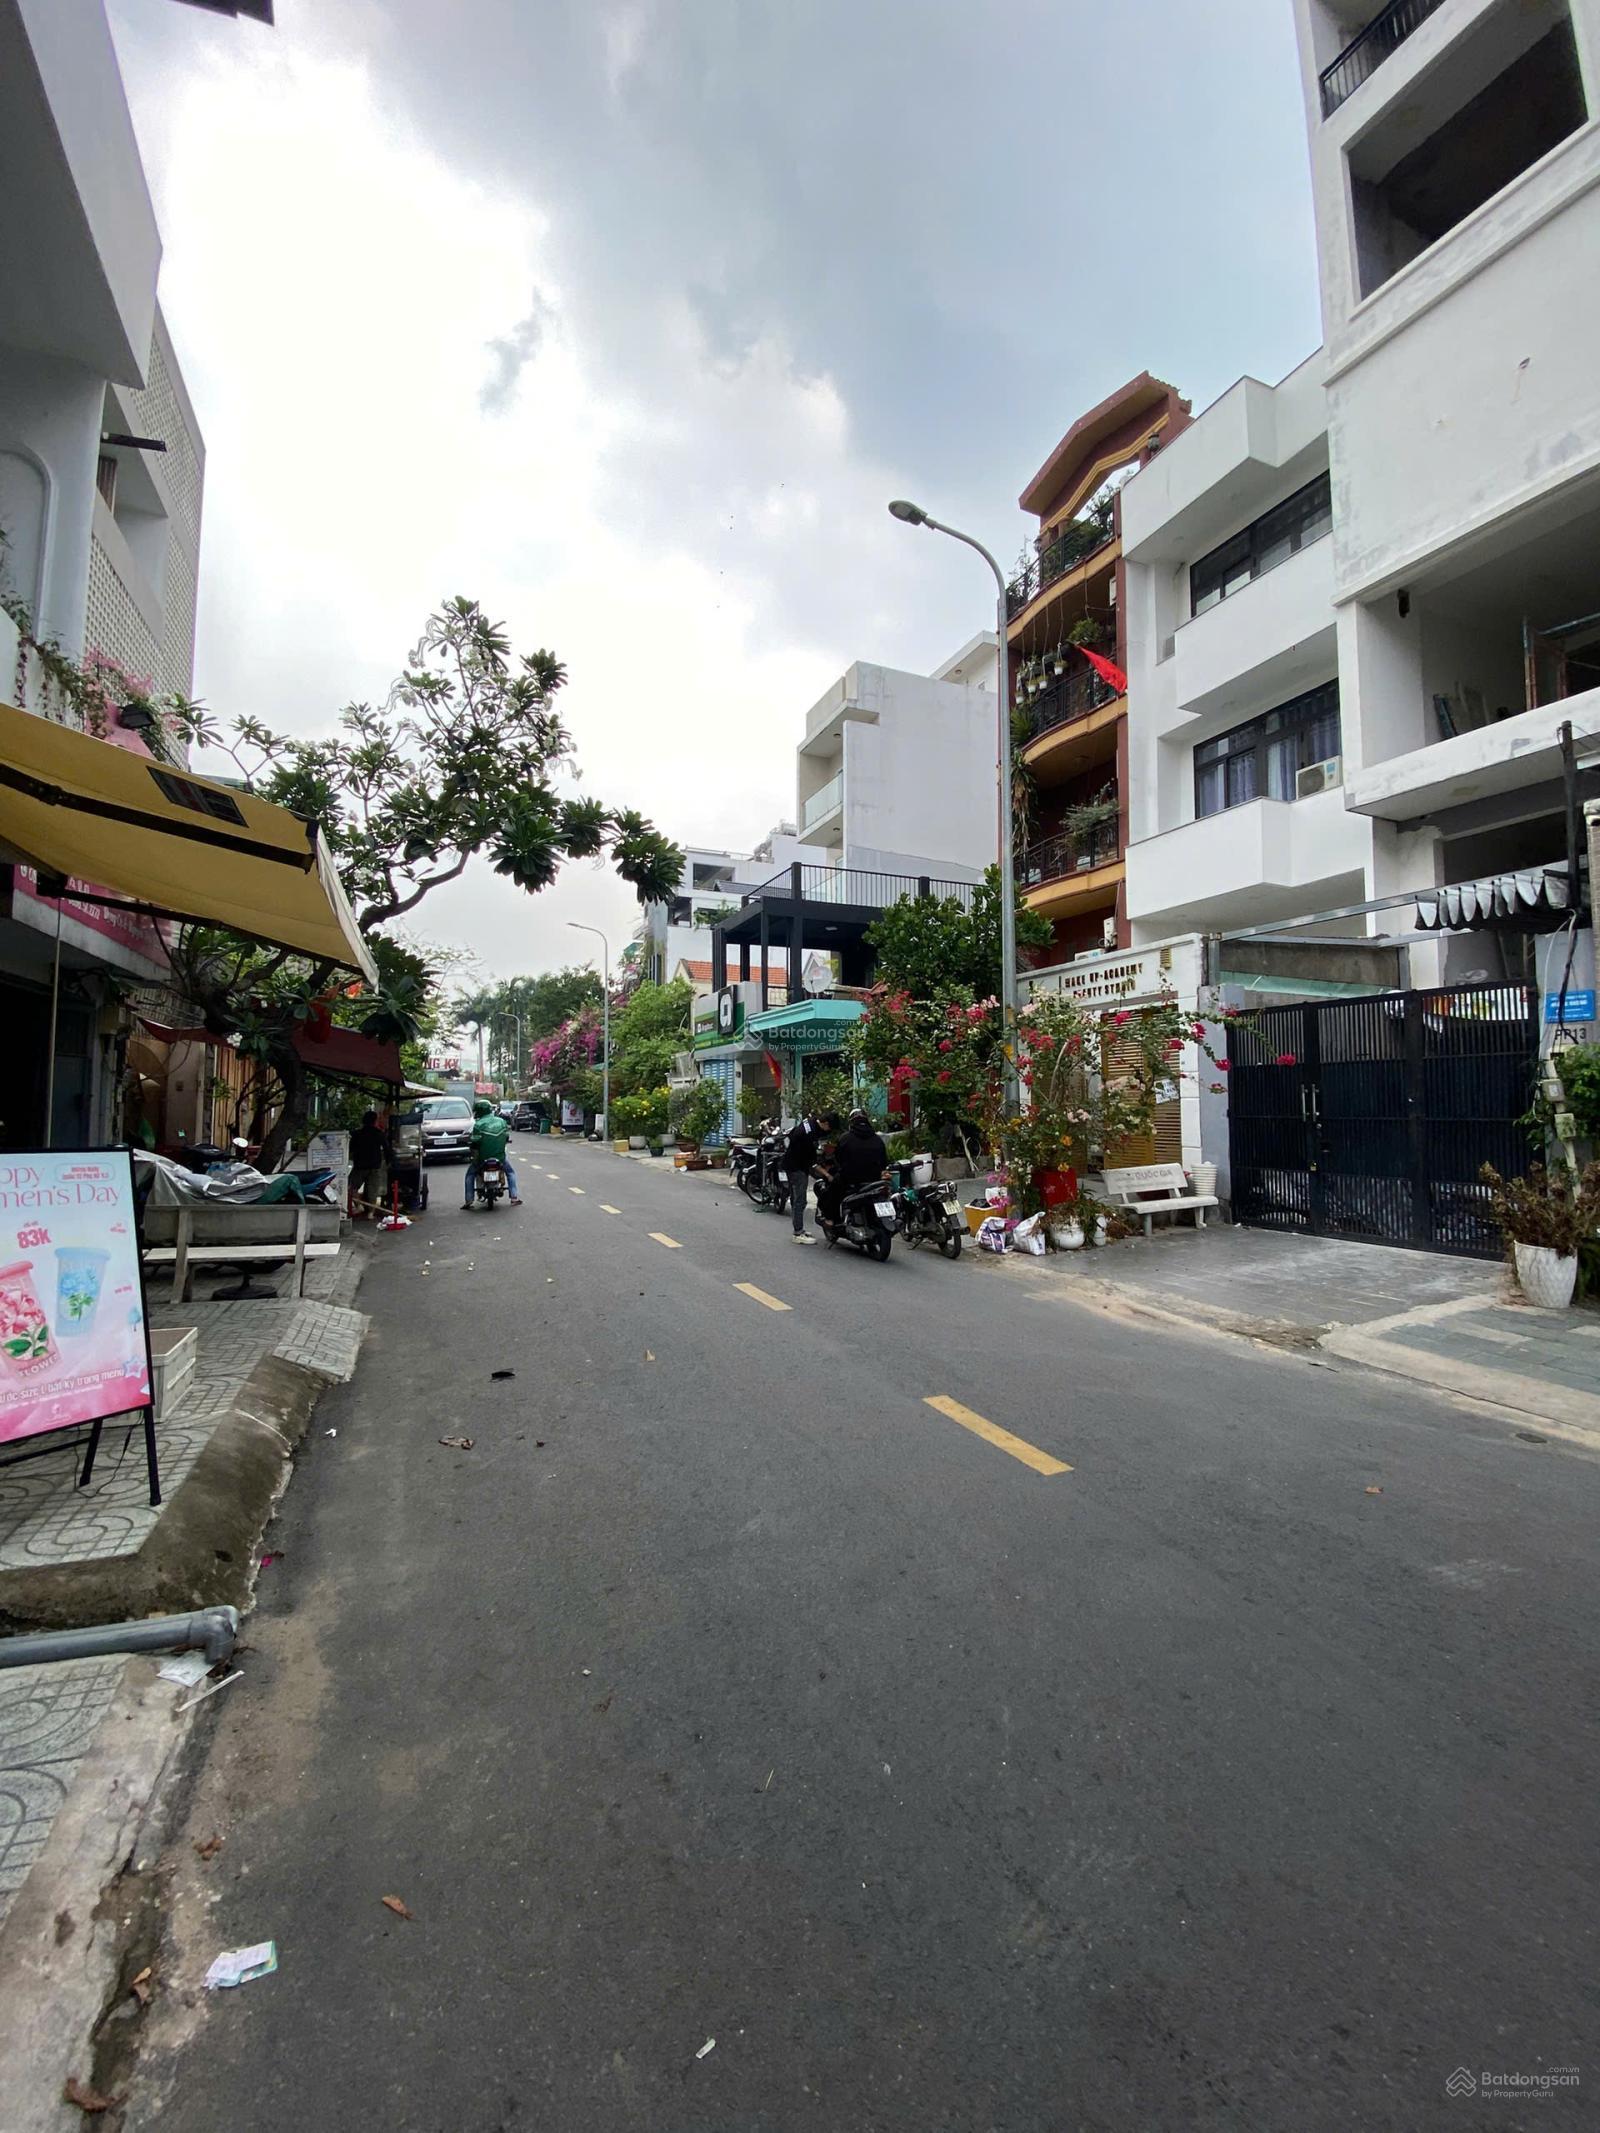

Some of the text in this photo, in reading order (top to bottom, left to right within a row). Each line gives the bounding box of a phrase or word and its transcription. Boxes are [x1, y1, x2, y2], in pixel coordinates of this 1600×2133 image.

[1065, 974, 1086, 988] MAKE
[76, 1183, 119, 1206] Day
[17, 1228, 52, 1249] 83K
[101, 1367, 125, 1380] menu
